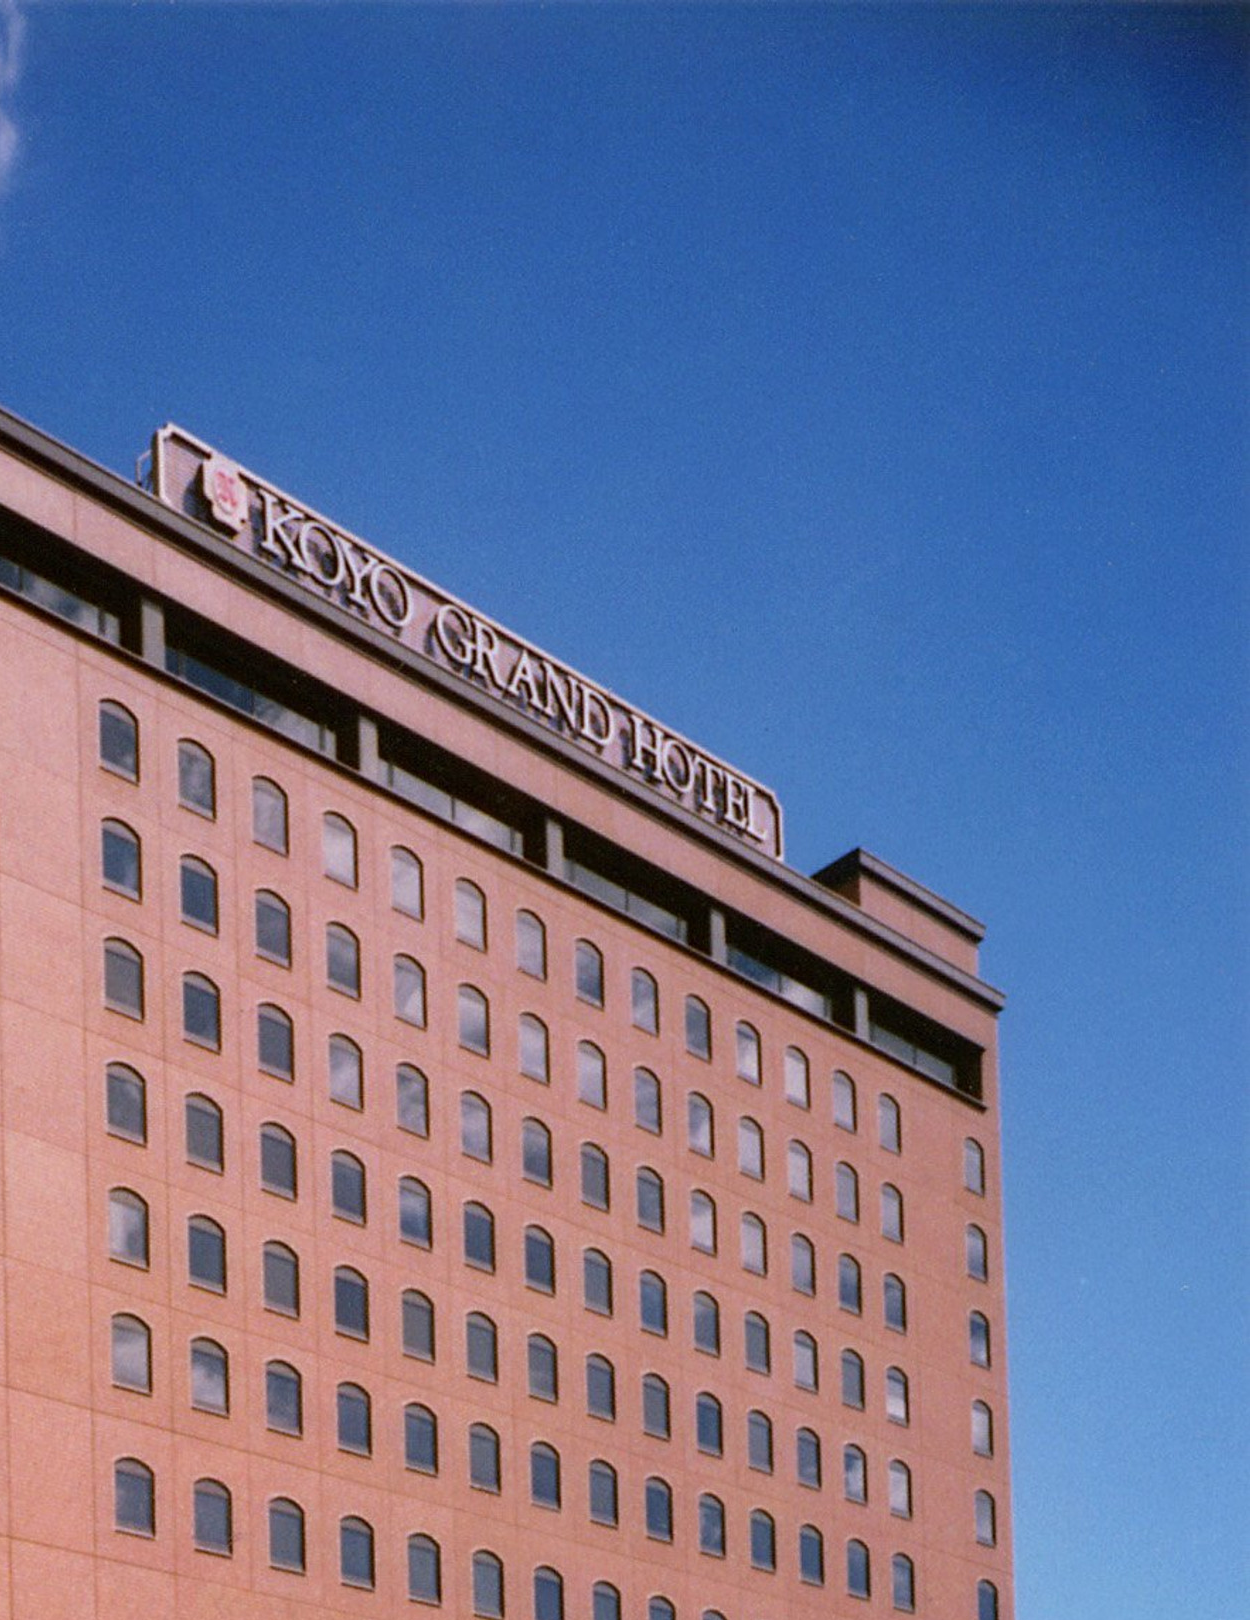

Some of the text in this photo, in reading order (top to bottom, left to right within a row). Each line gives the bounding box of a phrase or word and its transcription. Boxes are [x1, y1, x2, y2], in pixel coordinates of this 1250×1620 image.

[258, 489, 768, 841] KOYO GRAND HOTEL
